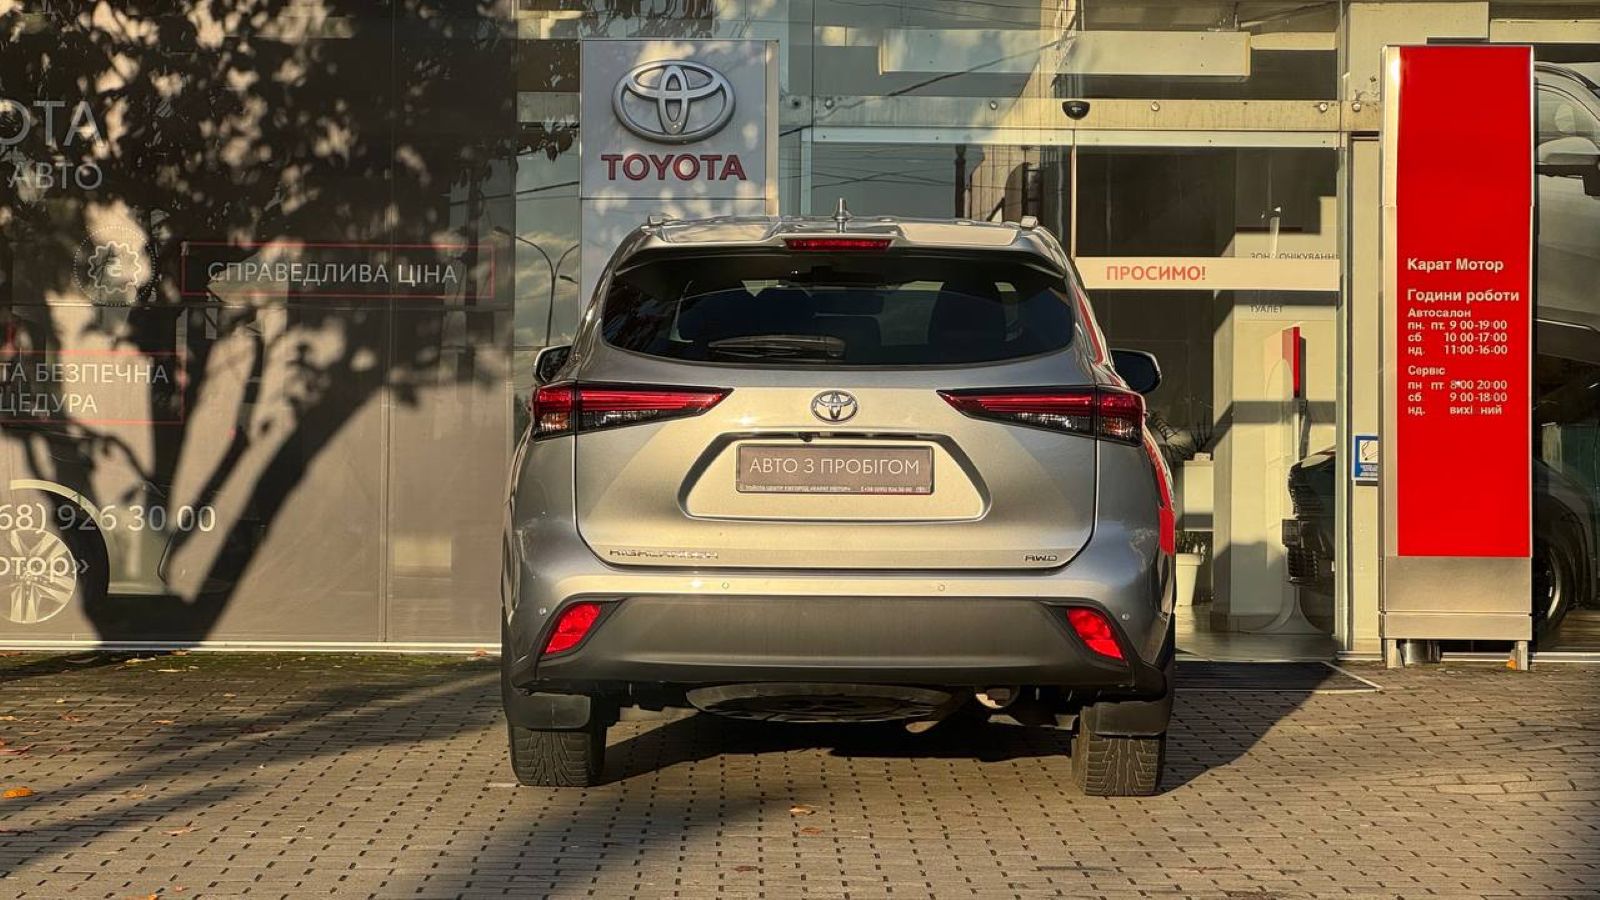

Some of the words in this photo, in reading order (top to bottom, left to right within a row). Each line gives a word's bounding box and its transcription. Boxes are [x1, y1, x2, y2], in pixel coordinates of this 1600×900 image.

[8, 161, 103, 190] АВТО
[600, 153, 747, 181] TOYOTA
[1106, 265, 1206, 281] ПРОСИМО!
[1407, 258, 1452, 273] Карат
[1456, 258, 1504, 273] Мотор
[207, 262, 389, 287] СПРАВЕДЛИВА
[397, 264, 458, 288] ЦІНА
[1407, 288, 1462, 303] Години
[1466, 288, 1520, 304] роботи
[1407, 307, 1472, 318] Автосалон
[36, 363, 169, 383] БЕЗПЕЧНА
[1407, 365, 1446, 377] Сервіс
[750, 458, 798, 473] АВТО
[803, 458, 815, 473] З
[820, 459, 920, 475] ПРОБІГОМ
[58, 505, 117, 531] 926
[128, 506, 166, 531] 30
[177, 506, 216, 532] 00
